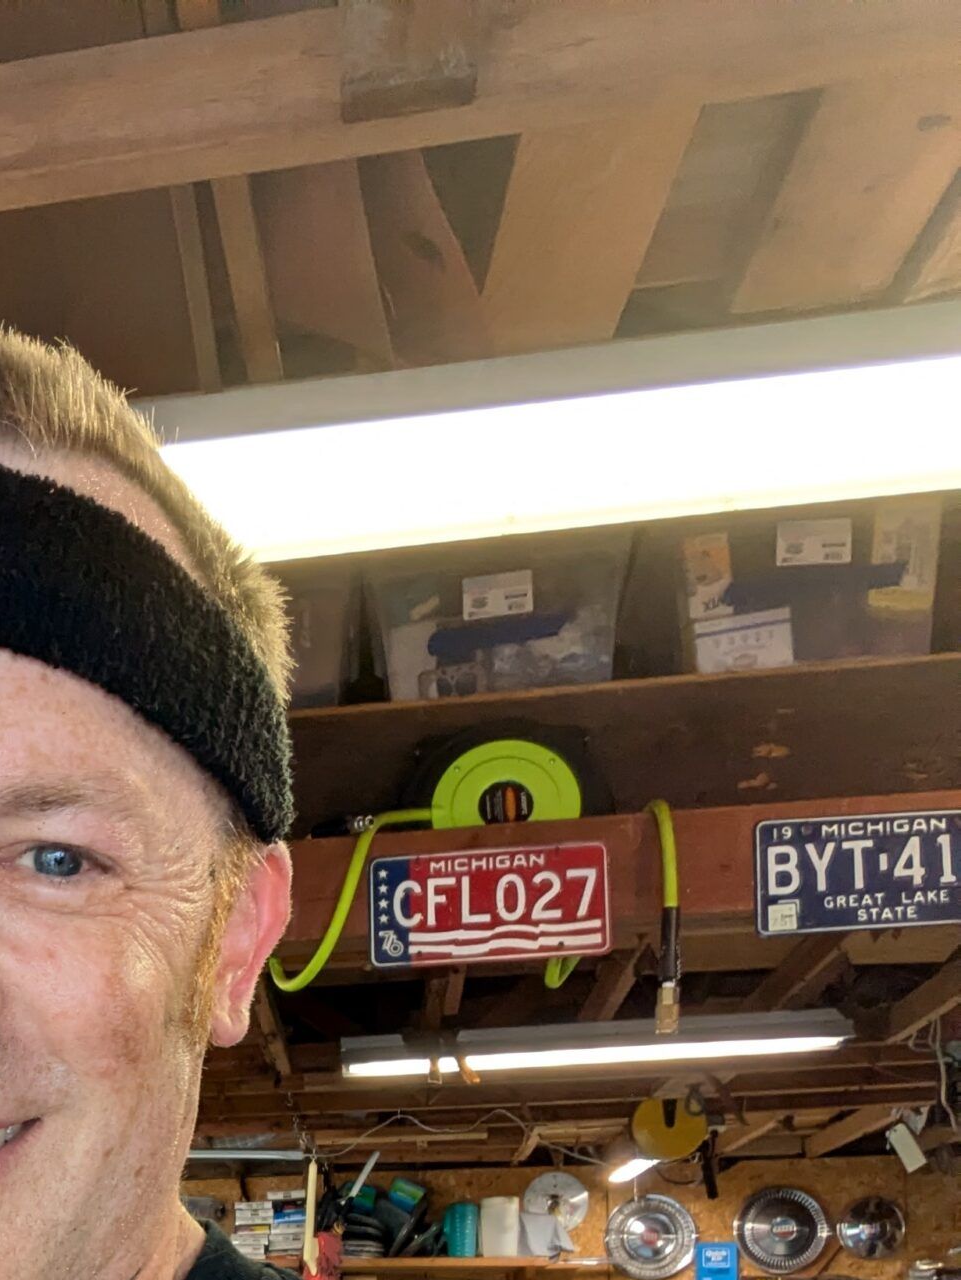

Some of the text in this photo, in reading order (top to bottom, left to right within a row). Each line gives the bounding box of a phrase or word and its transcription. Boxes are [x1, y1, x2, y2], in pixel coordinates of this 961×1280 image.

[773, 818, 947, 841] 19 MICHIGAN
[429, 853, 546, 873] MICHIGAN
[393, 867, 598, 928] CFL027
[824, 892, 885, 909] GREAT
[857, 905, 918, 922] STATE
